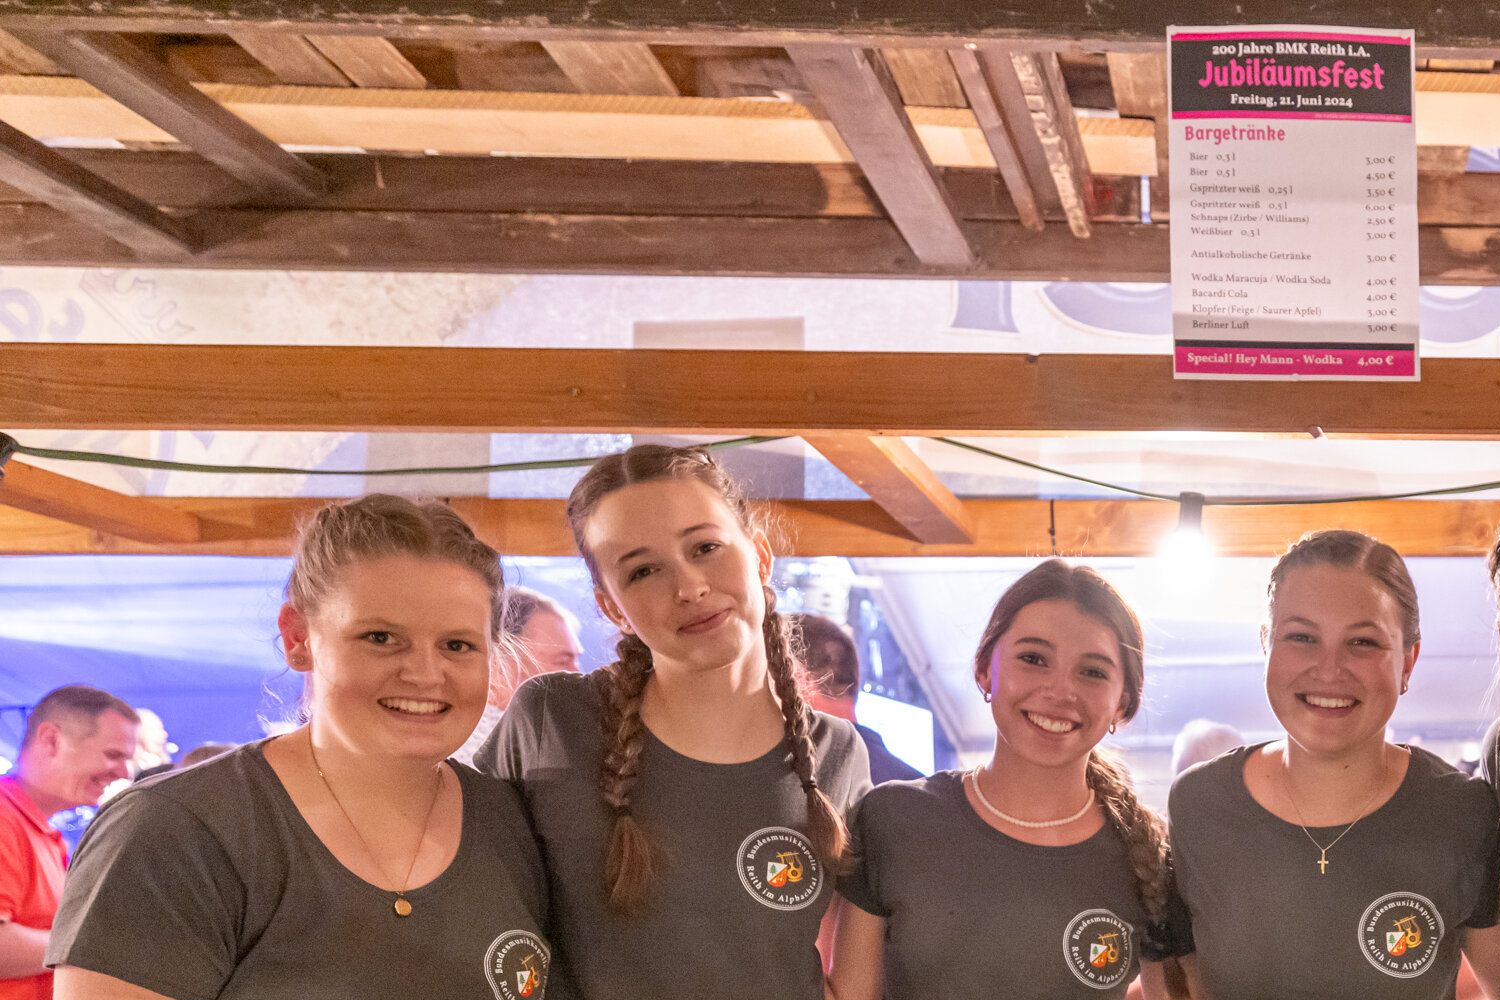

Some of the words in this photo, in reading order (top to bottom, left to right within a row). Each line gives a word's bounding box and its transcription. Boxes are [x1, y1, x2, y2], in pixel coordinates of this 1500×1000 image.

[1212, 45, 1236, 55] 200
[1238, 42, 1273, 56] Jahre
[1275, 43, 1308, 55] BMK
[1310, 43, 1346, 56] Reith
[1348, 44, 1371, 57] i.A.
[1198, 58, 1385, 90] Jubiläumsfest
[1230, 93, 1277, 107] Freitag,
[1279, 97, 1295, 106] 21.
[1297, 95, 1323, 108] Juni
[1324, 97, 1353, 108] 2024
[1184, 125, 1286, 145] Bargetränke
[1190, 152, 1208, 161] Bier
[1388, 155, 1396, 165] €
[1190, 168, 1208, 176] Bier
[1388, 171, 1396, 180] €
[1190, 183, 1237, 195] Gspritzter
[1238, 184, 1261, 193] weiß
[1388, 187, 1396, 197] €
[1190, 199, 1237, 210] Gspritzter
[1238, 201, 1261, 209] weiß
[1388, 203, 1396, 211] €
[1190, 214, 1228, 223] Schnaps
[1230, 214, 1258, 223] (Zirbe
[1265, 214, 1310, 224] Williams)
[1388, 217, 1396, 225] €
[1190, 227, 1233, 236] Weißbier
[1389, 231, 1397, 239] €
[1190, 250, 1268, 260] Antialkoholische
[1269, 251, 1312, 260] Getränke
[1389, 254, 1397, 262] €
[1191, 273, 1223, 282] Wodka
[1225, 273, 1268, 285] Maracuja
[1275, 274, 1308, 283] Wodka
[1309, 276, 1332, 285] Soda
[1390, 277, 1397, 286] €
[1191, 289, 1226, 297] Bacardi
[1227, 290, 1249, 298] Cola
[1390, 293, 1397, 301] €
[1192, 304, 1226, 315] Klopfer
[1227, 305, 1255, 316] (Feige
[1262, 306, 1292, 315] Saurer
[1294, 307, 1322, 317] Apfel)
[1390, 308, 1398, 316] €
[1192, 320, 1229, 329] Berliner
[1231, 321, 1249, 329] Luft
[1390, 323, 1398, 332] €
[1187, 352, 1233, 364] Special!
[1235, 353, 1258, 367] Hey
[1260, 354, 1294, 365] Mann
[1303, 354, 1343, 365] Wodka
[1358, 356, 1384, 366] 4,00
[1386, 356, 1394, 365] €
[746, 835, 817, 872] Bundesmusikkapelle
[746, 865, 762, 890] Reith
[762, 888, 775, 900] im
[777, 877, 818, 905] Alpbachtal
[1366, 899, 1435, 932] Bundesmusikkapelle
[1367, 938, 1385, 962] Reith
[1386, 958, 1399, 969] im
[1402, 936, 1438, 971] Alpbachtal
[1071, 946, 1085, 970] Reith
[1084, 968, 1095, 979] im
